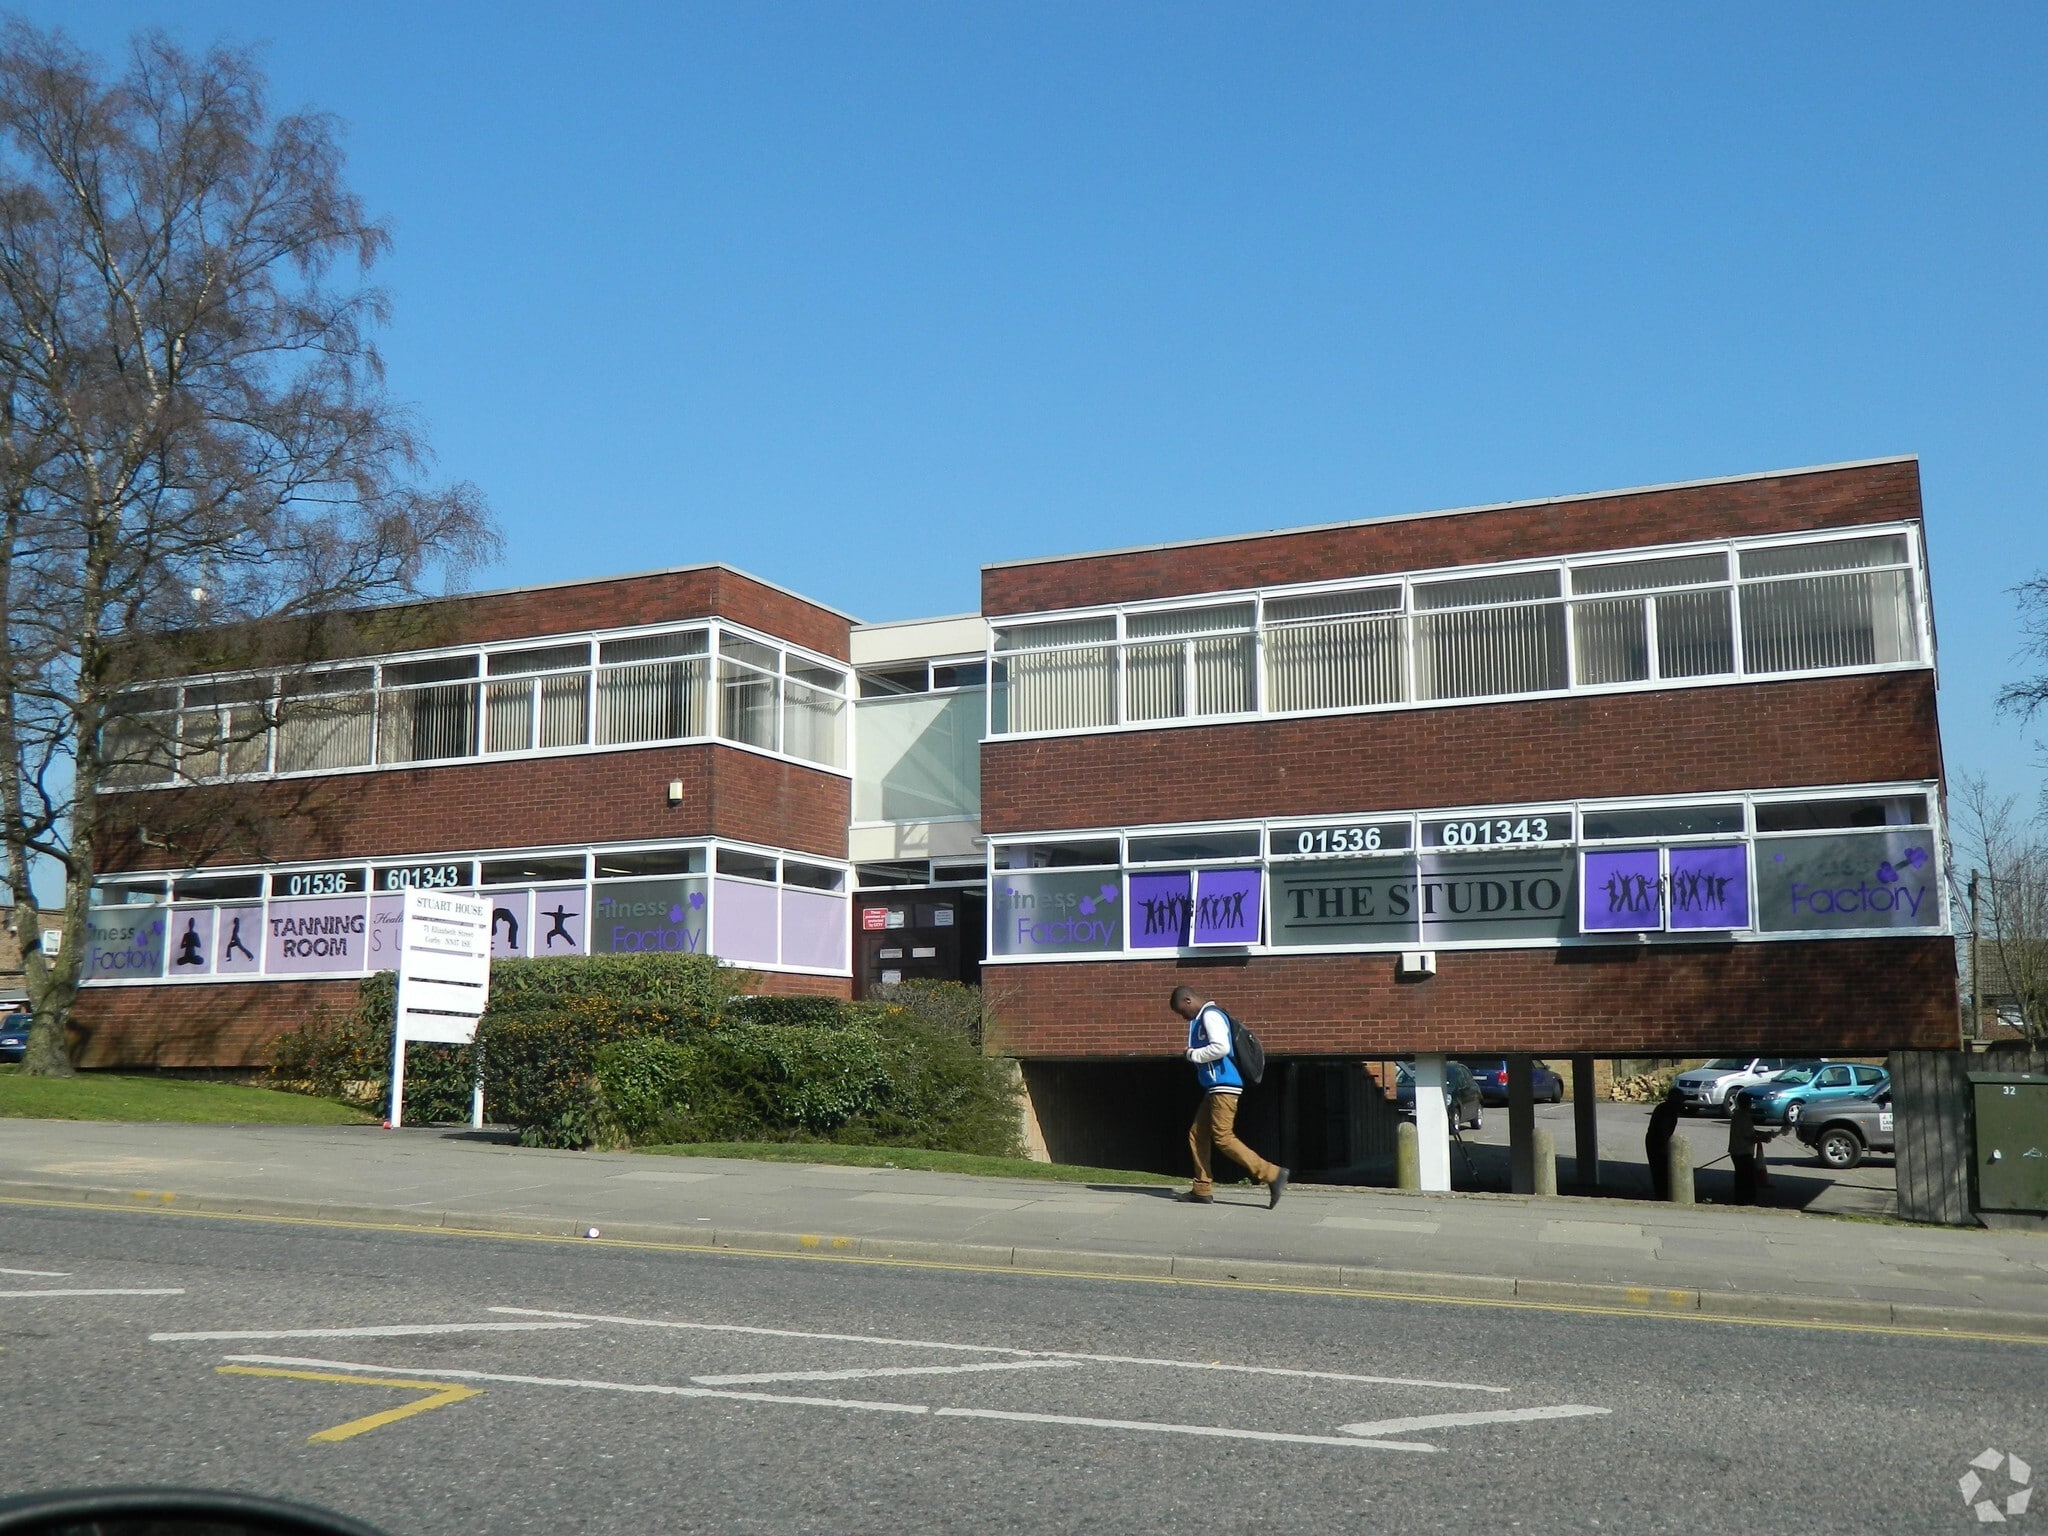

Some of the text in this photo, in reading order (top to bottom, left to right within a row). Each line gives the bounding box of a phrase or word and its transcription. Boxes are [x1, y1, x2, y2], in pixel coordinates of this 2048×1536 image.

[1298, 818, 1549, 853] 01536 601343
[290, 866, 458, 895] 01536 601343
[416, 897, 484, 916] STUART HOUSE
[595, 897, 668, 919] Fitness
[1287, 878, 1561, 919] THE STUDIO
[1790, 881, 1926, 917] Factory
[270, 914, 365, 937] TANNING
[612, 923, 701, 953] Factory
[1017, 916, 1116, 949] Factory
[91, 946, 161, 973] Factory
[283, 937, 347, 958] ROOM
[2002, 1086, 2016, 1095] 32
